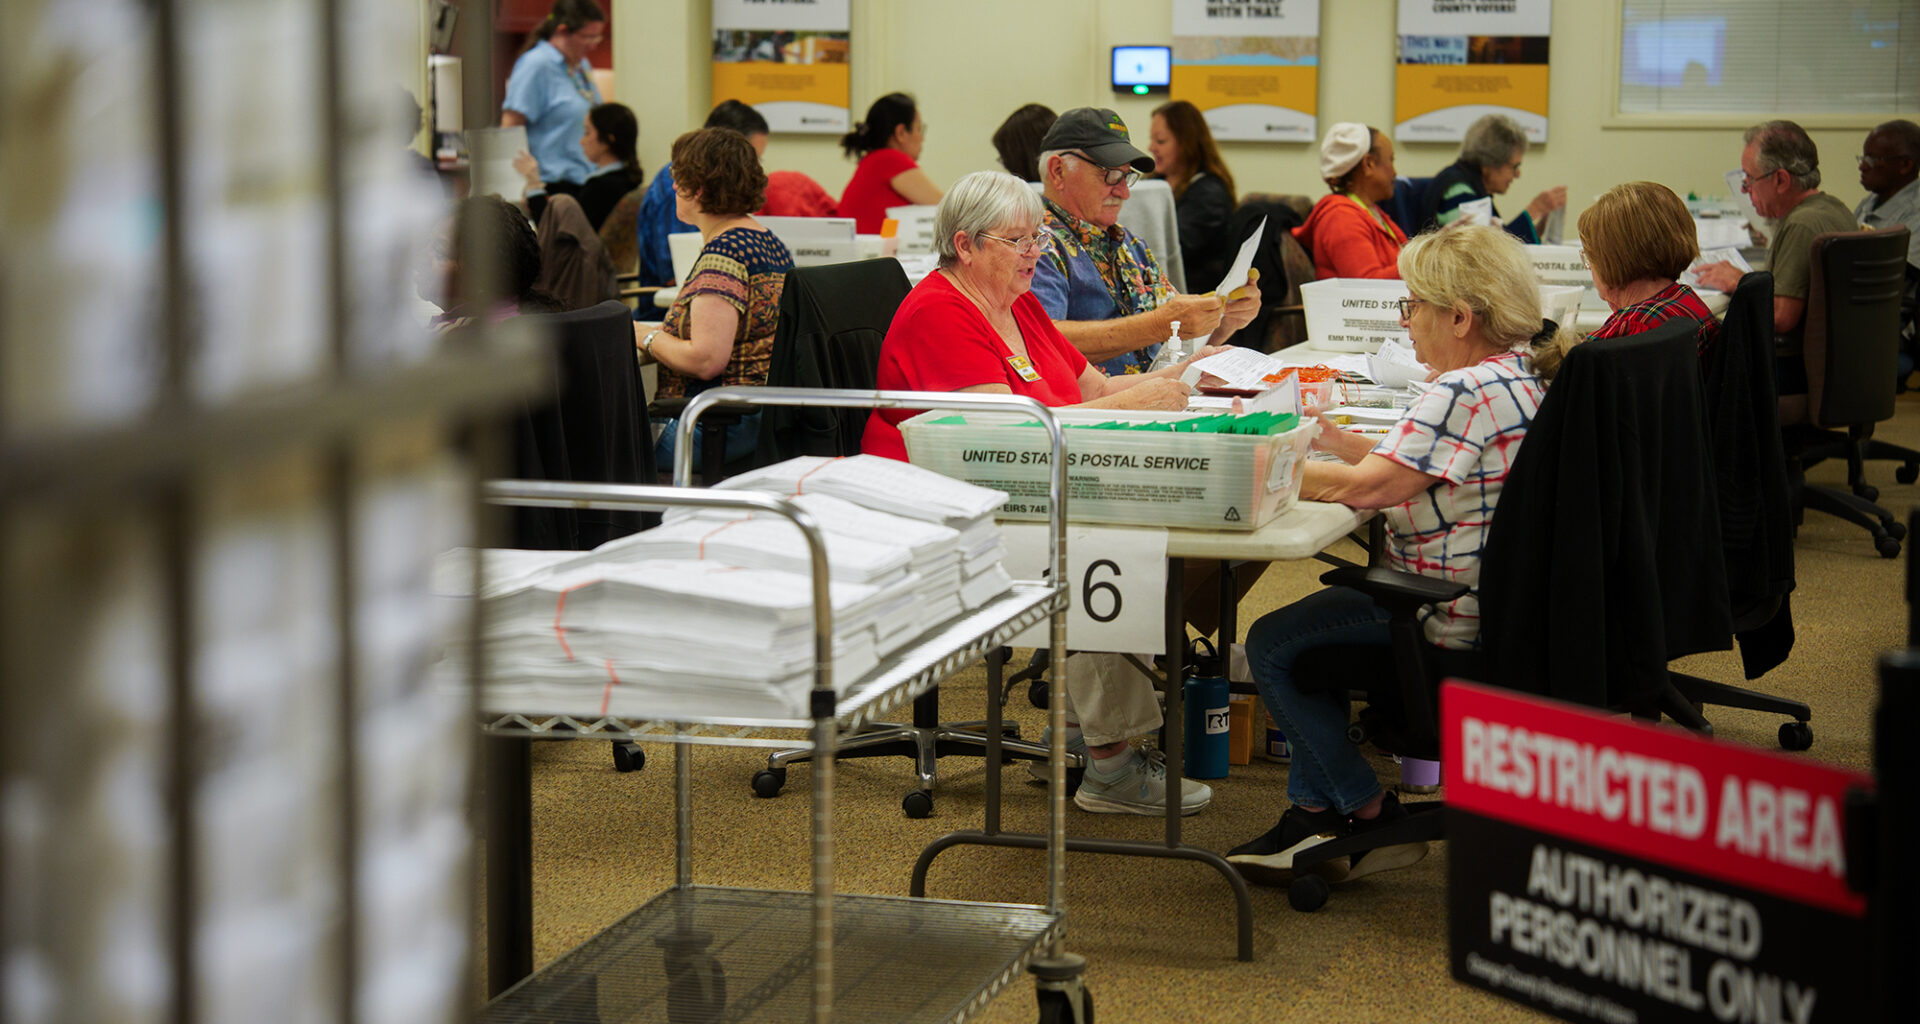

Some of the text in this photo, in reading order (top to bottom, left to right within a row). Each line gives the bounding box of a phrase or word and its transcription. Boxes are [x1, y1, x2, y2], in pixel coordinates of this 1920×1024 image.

[1342, 299, 1379, 309] UNITED
[963, 450, 1211, 471] UNITED STATS POSTAL SERVICE
[1003, 503, 1027, 513] EIRS
[1029, 504, 1048, 514] 74E
[1462, 715, 1846, 879] RESTRICTED AREA
[1527, 843, 1762, 961] AUTHORIZED
[1489, 891, 1818, 1024] PERSONNEL ONLY
